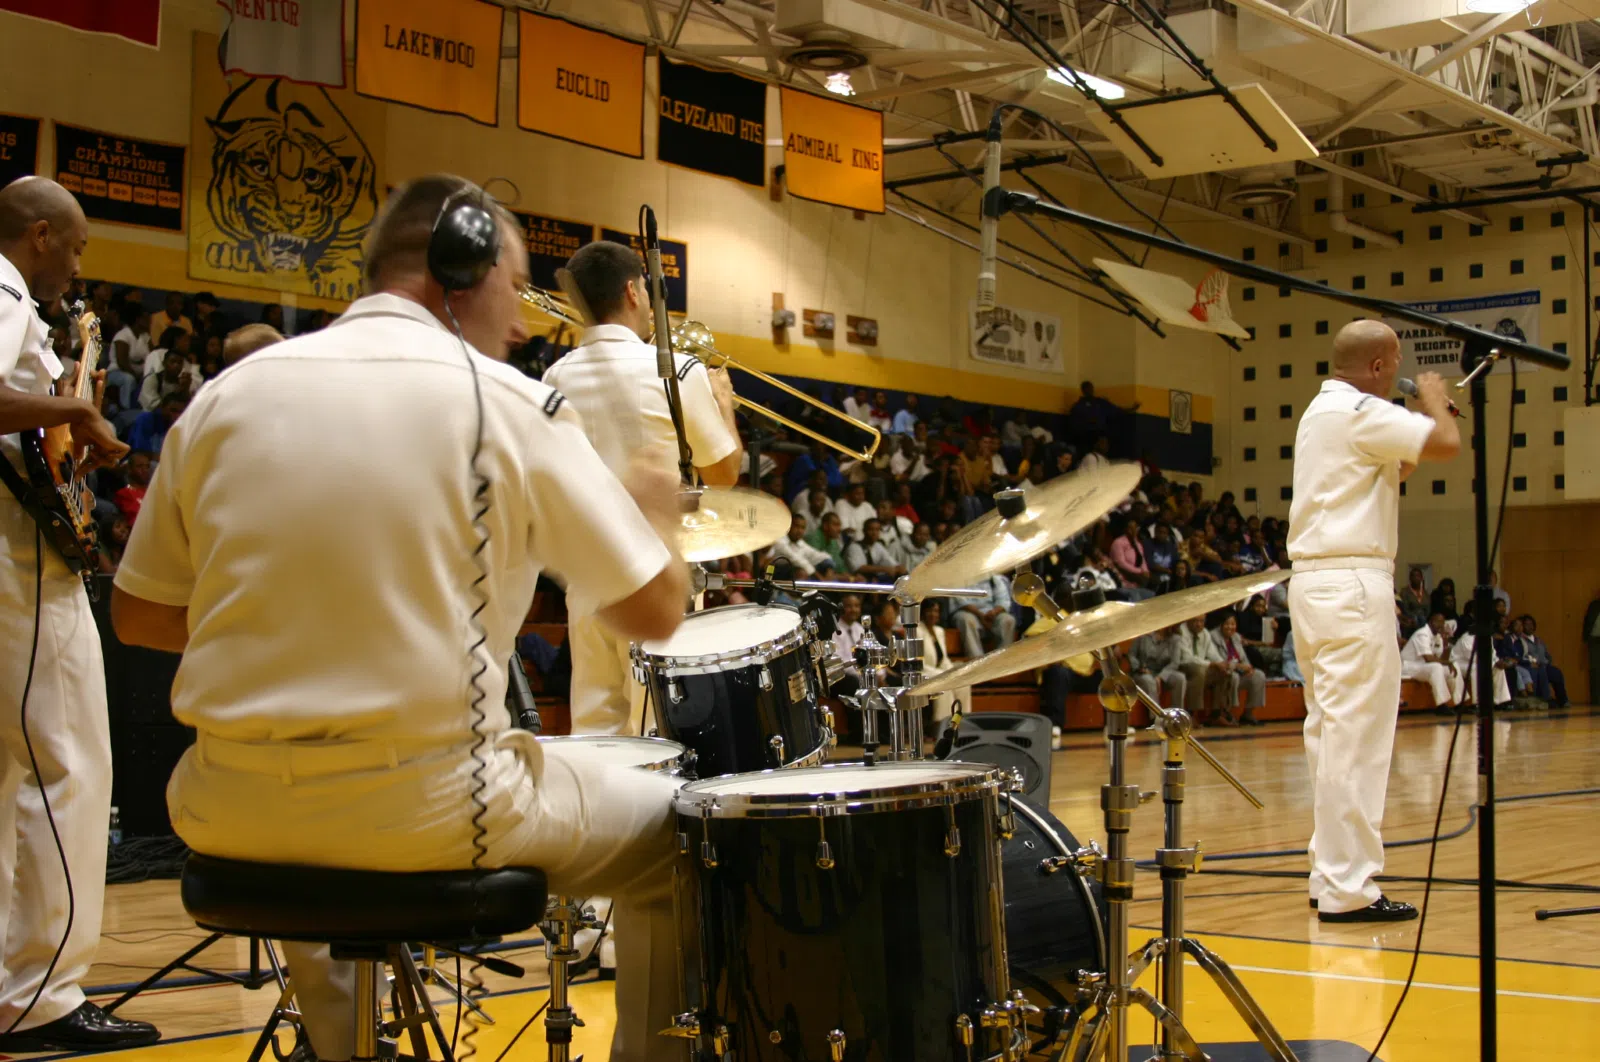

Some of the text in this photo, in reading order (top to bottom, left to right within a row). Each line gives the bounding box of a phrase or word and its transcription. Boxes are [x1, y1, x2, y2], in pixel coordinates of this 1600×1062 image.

[384, 24, 475, 68] LAKEWOOD
[556, 67, 610, 102] EUCLID
[660, 95, 735, 136] CLEVELAND
[75, 146, 167, 173] CHAMPIONS
[785, 132, 879, 171] ADMIRAL KING
[68, 159, 99, 177] GIRLS
[107, 167, 171, 188] BASKETBALL
[1414, 340, 1461, 352] HEIGHTS
[1416, 353, 1459, 365] TIGERS!
